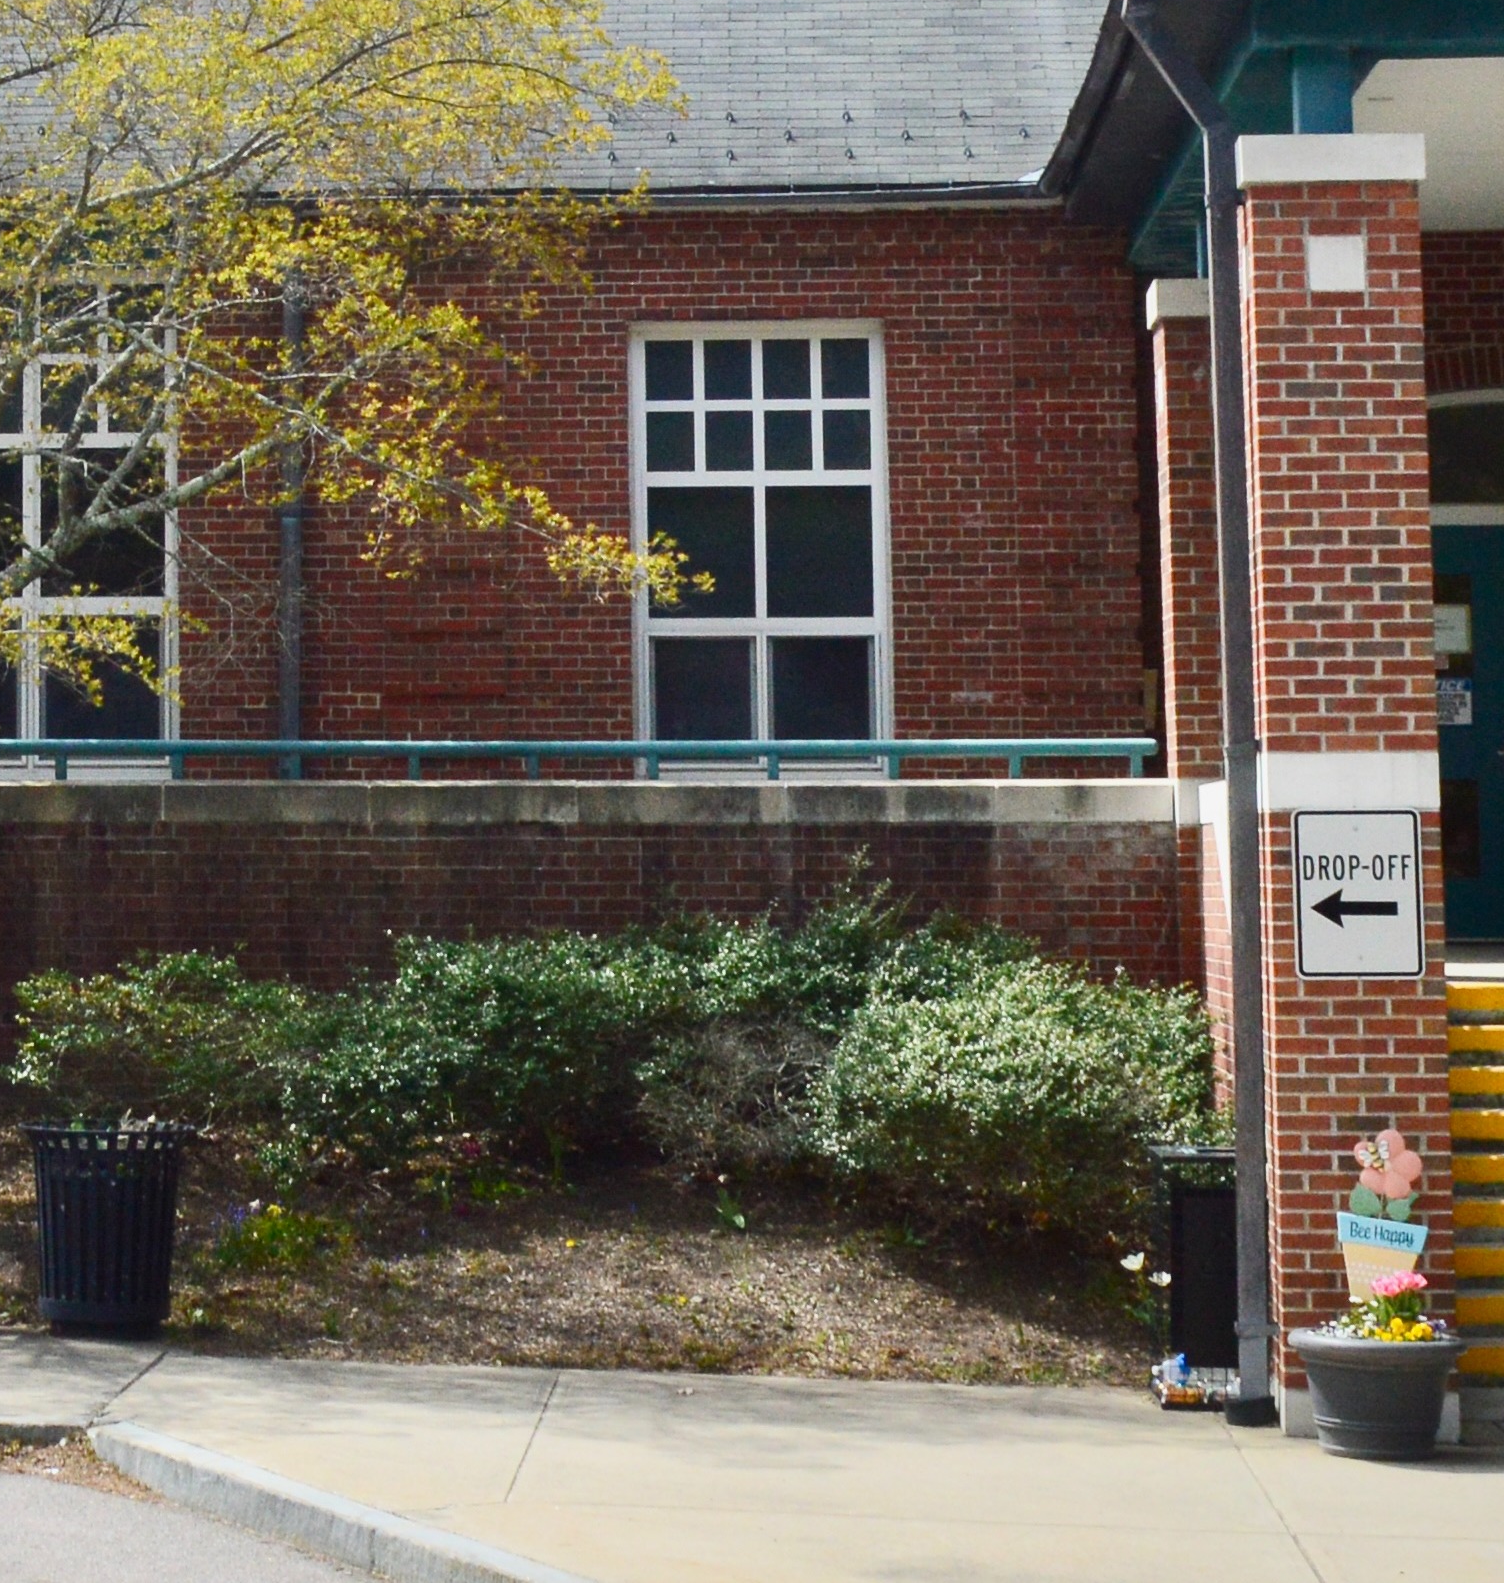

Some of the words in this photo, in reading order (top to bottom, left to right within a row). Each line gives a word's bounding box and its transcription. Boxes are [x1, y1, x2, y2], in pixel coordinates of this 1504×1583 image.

[1302, 854, 1412, 881] DROP-OFF
[1350, 1221, 1372, 1240] Bee
[1374, 1224, 1414, 1247] Happy
